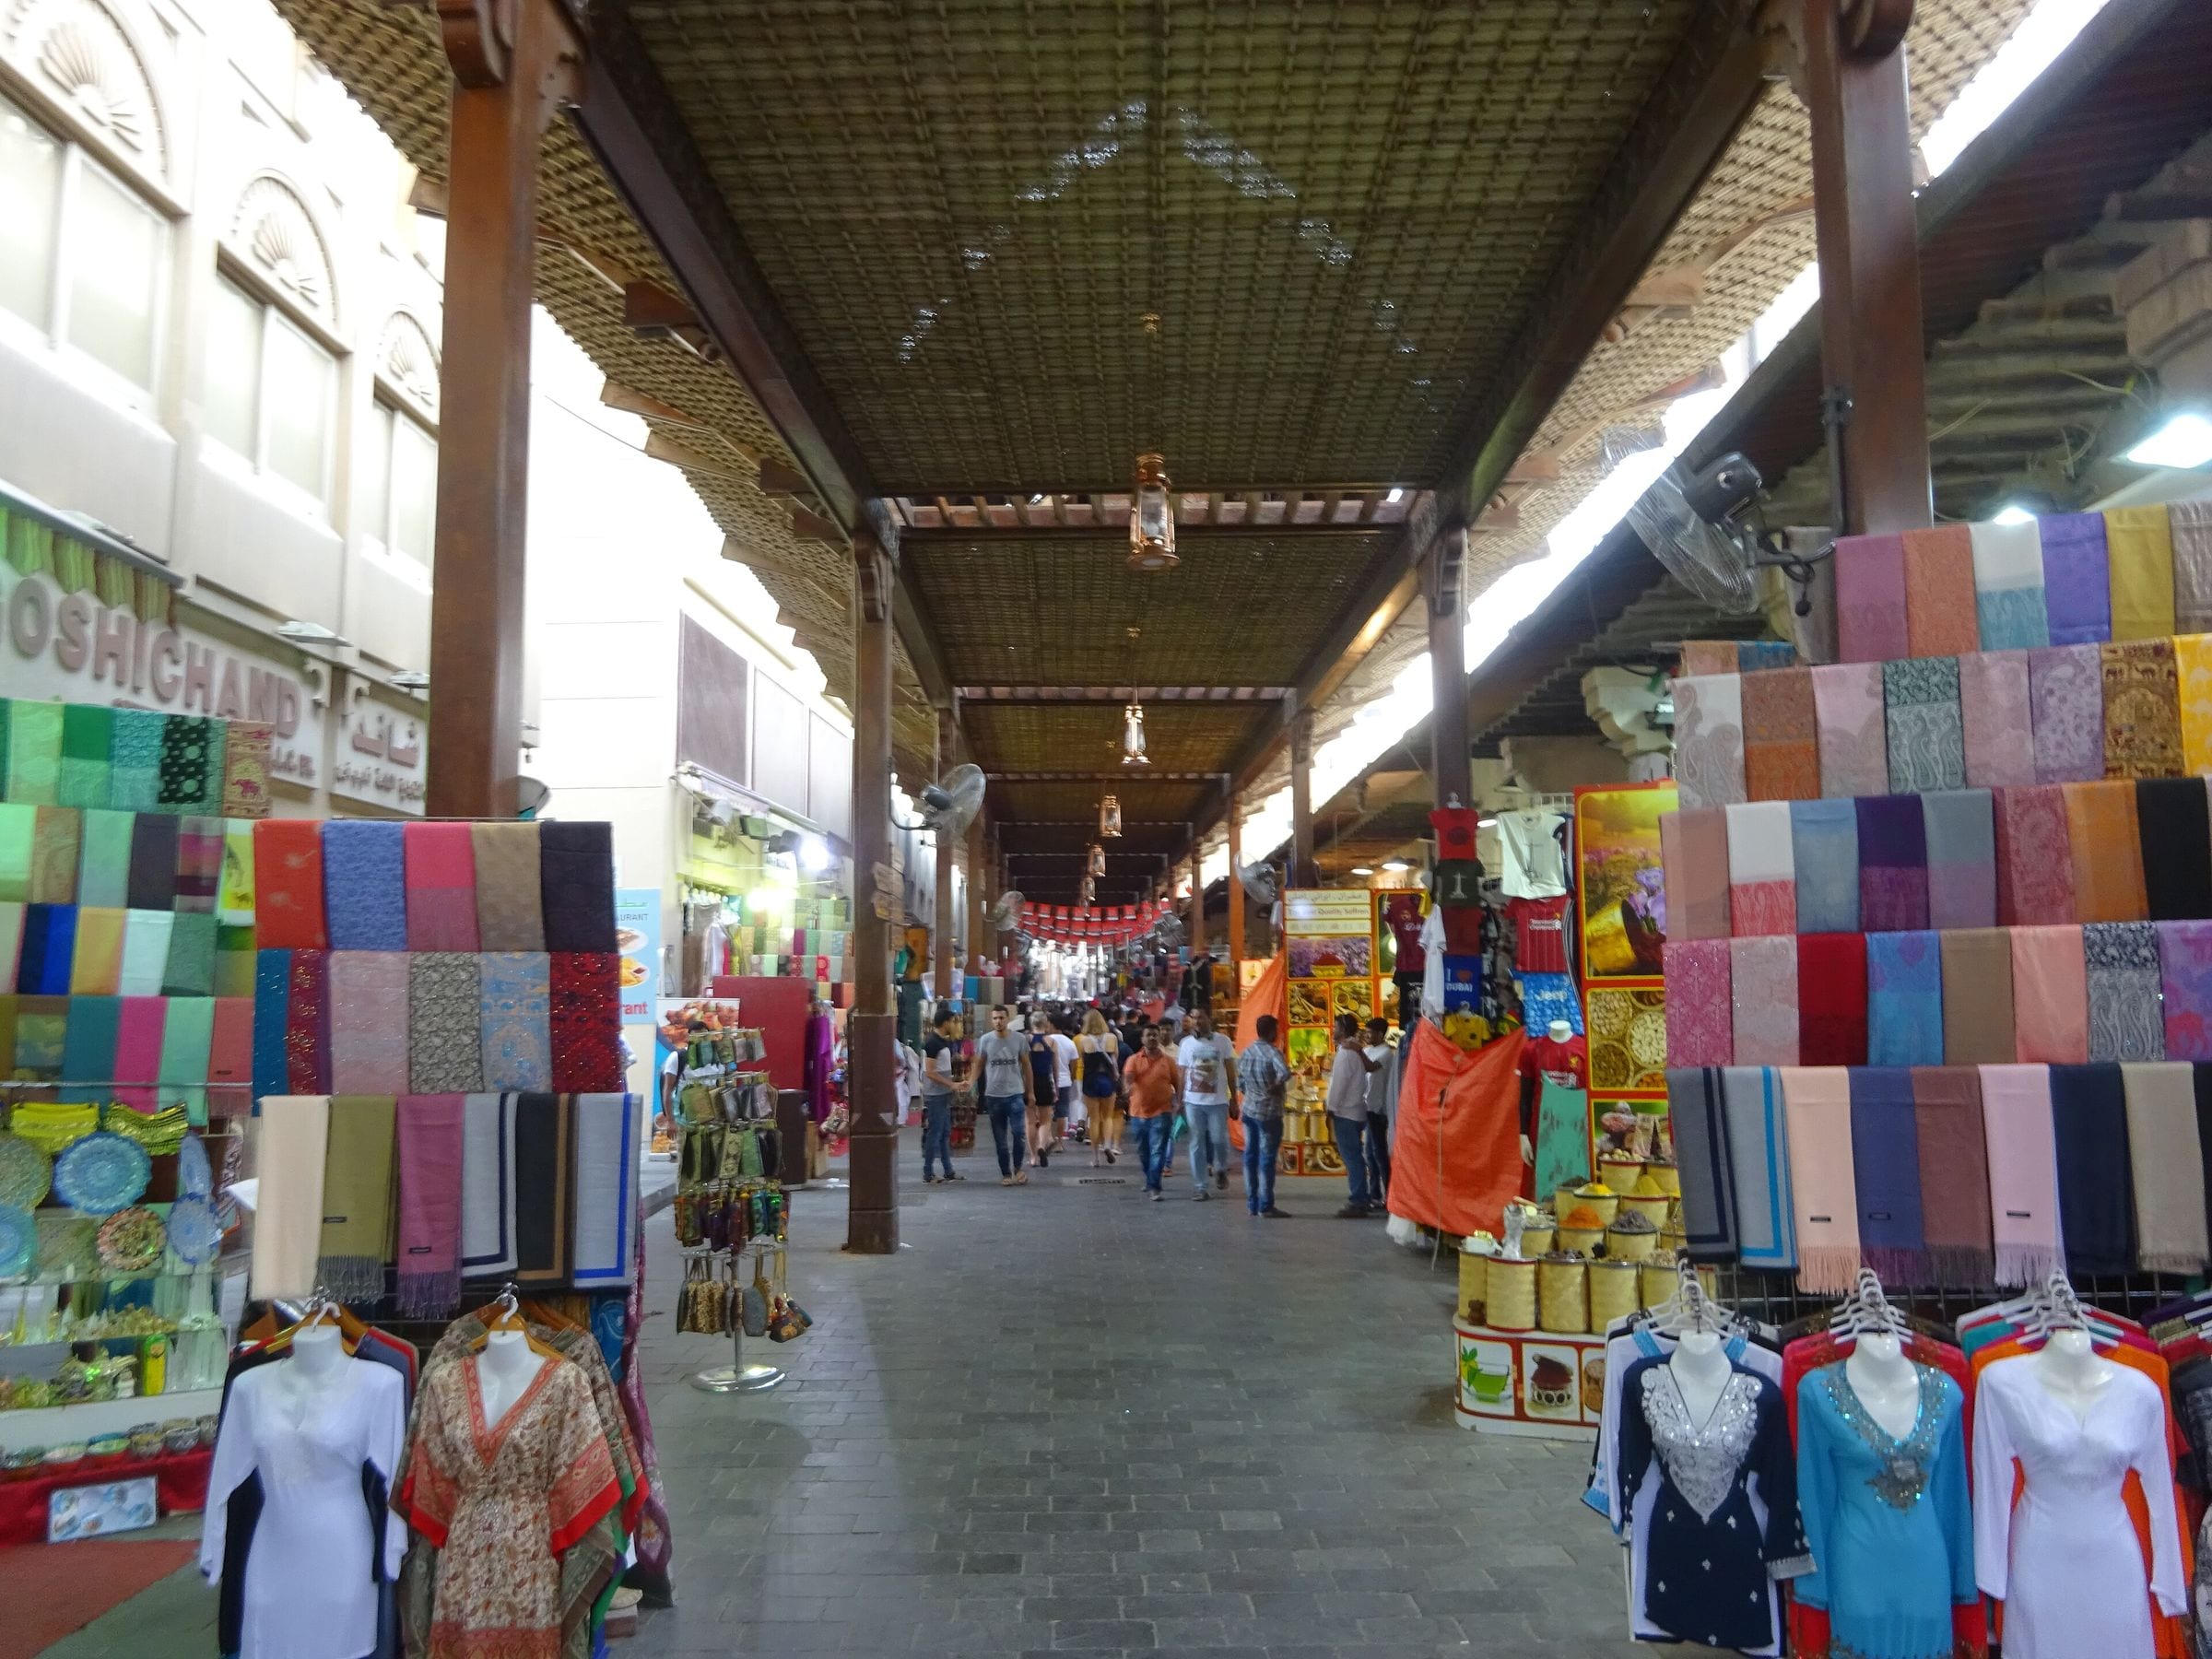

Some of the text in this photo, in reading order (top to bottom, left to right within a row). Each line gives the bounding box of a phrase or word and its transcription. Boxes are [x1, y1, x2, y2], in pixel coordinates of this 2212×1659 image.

[2, 578, 302, 739] OSHICHAND
[617, 913, 649, 922] URANT
[1446, 982, 1473, 993] DUBAI
